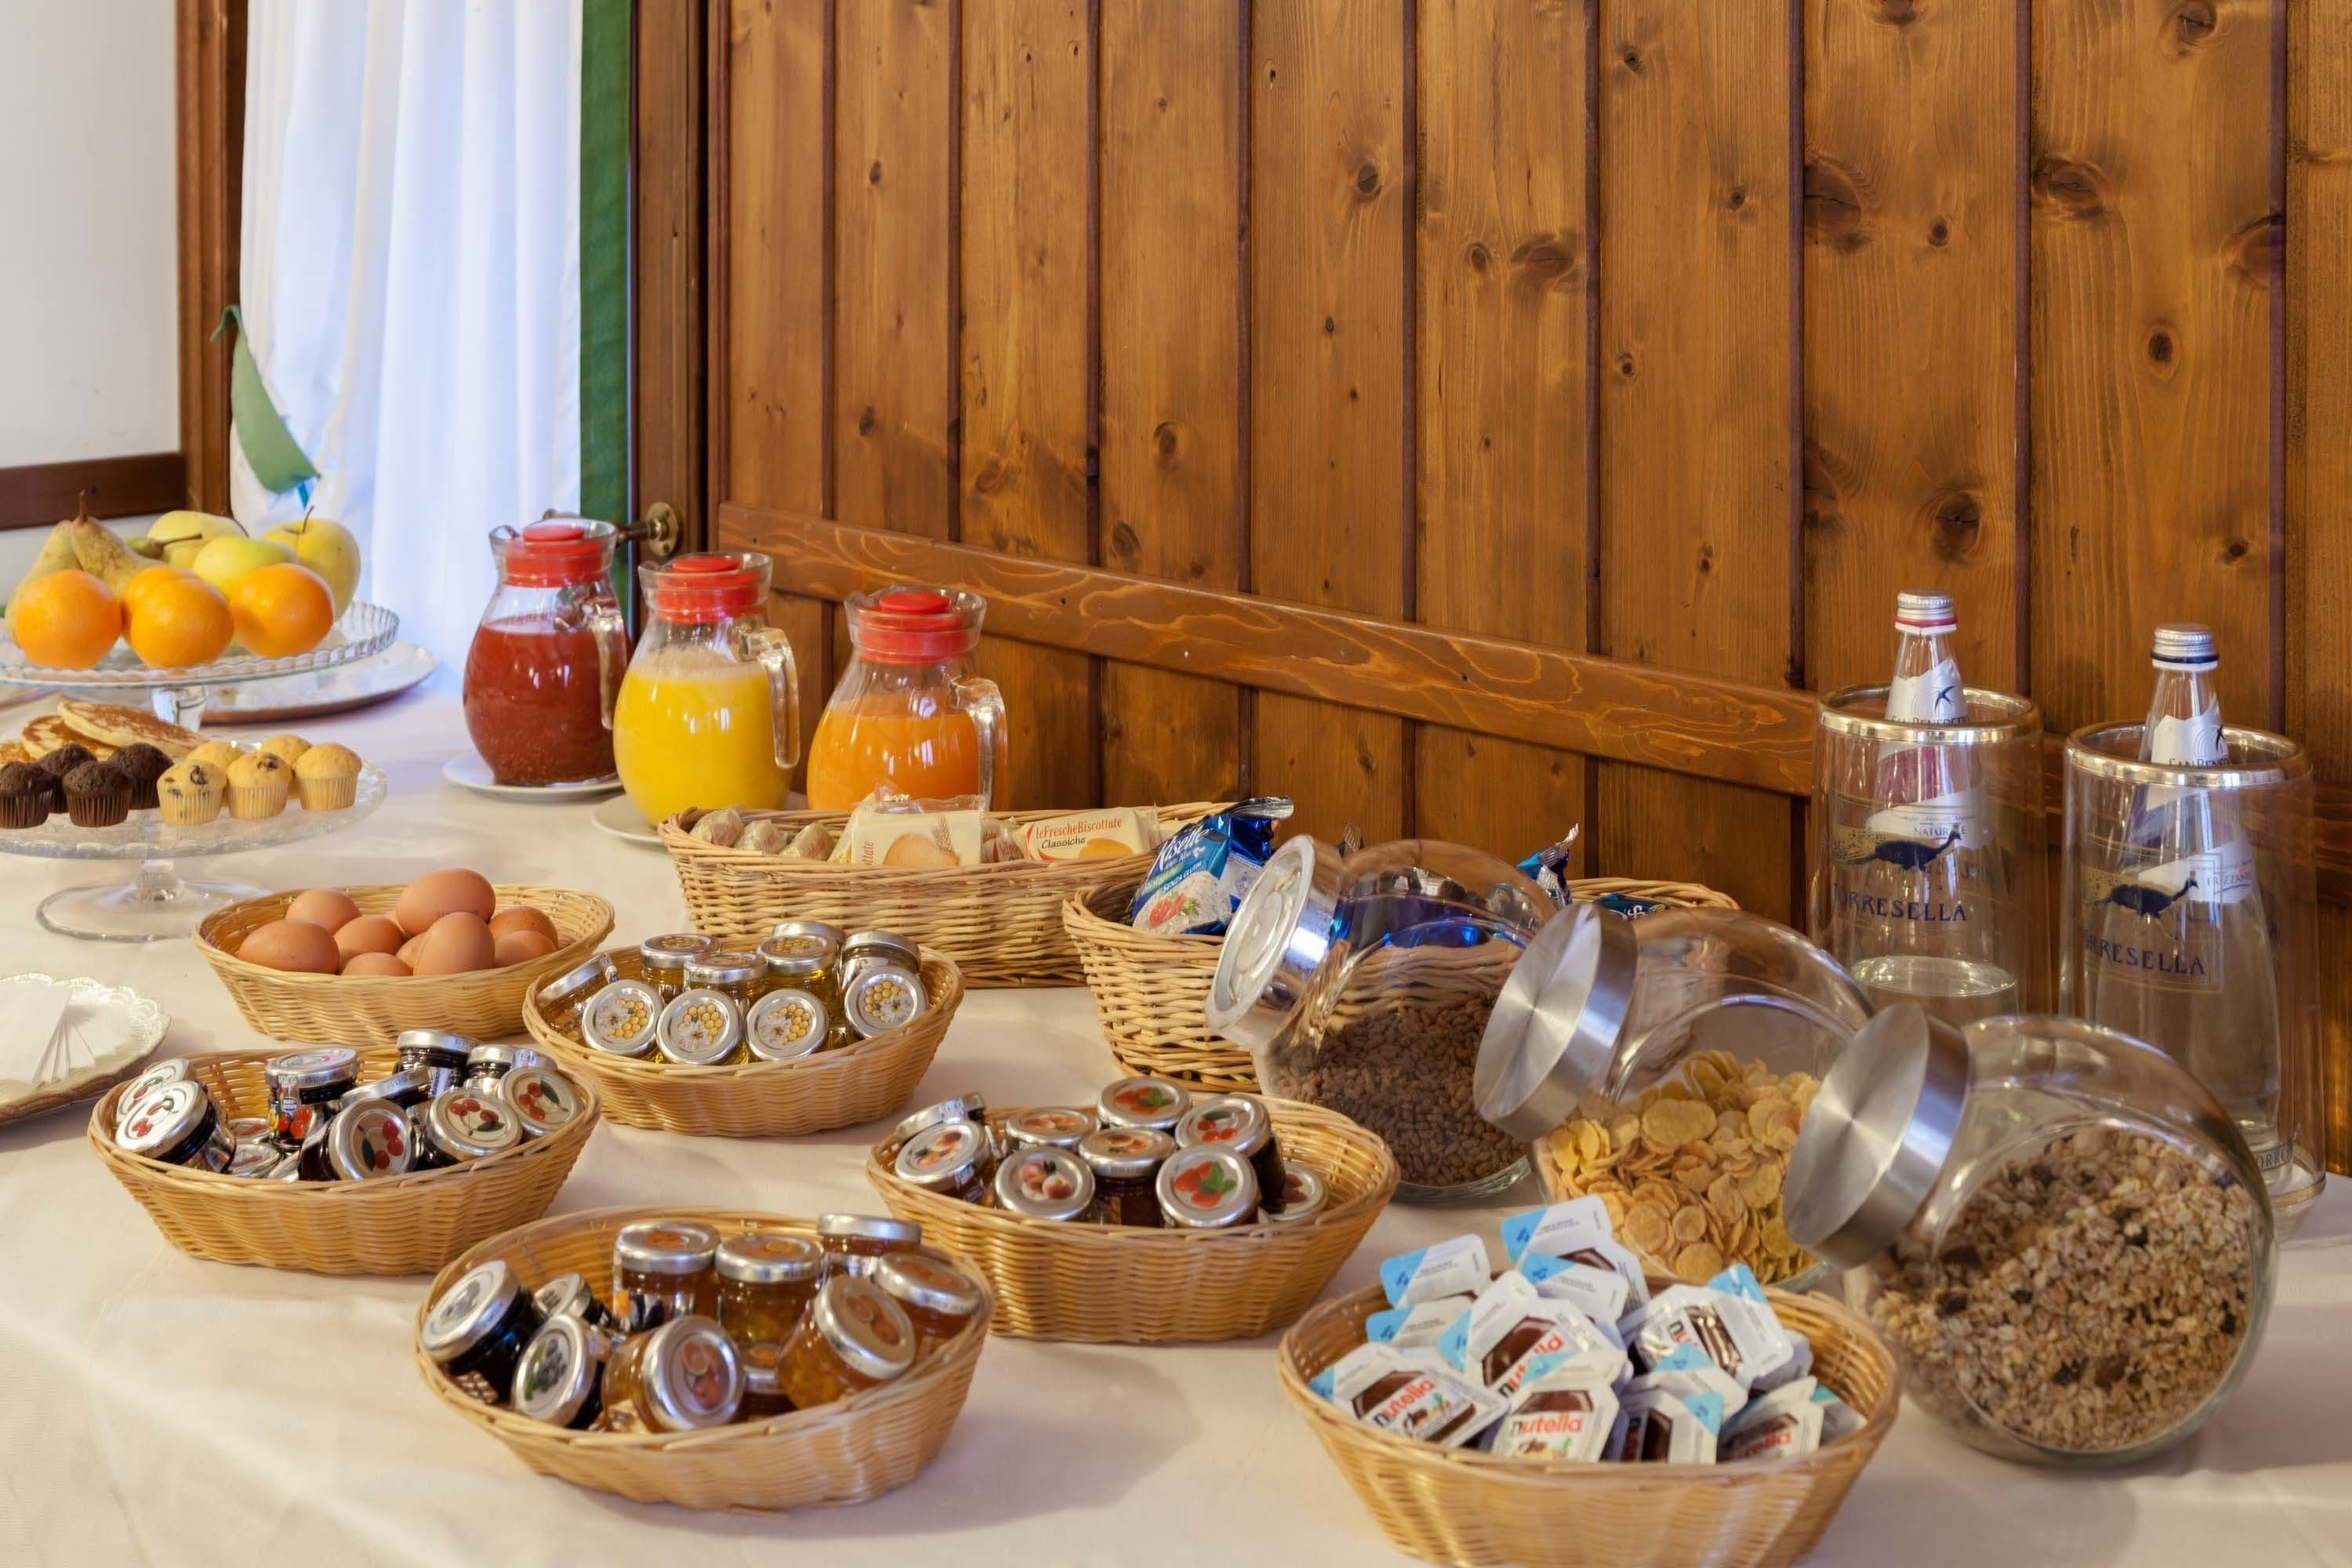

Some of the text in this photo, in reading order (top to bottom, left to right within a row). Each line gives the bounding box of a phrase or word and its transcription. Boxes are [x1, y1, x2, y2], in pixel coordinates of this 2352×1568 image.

[1914, 826, 1968, 837] NATURE
[1041, 836, 1086, 849] Classiche
[1374, 1379, 1436, 1426] nutella
[1511, 1412, 1584, 1437] nutella
